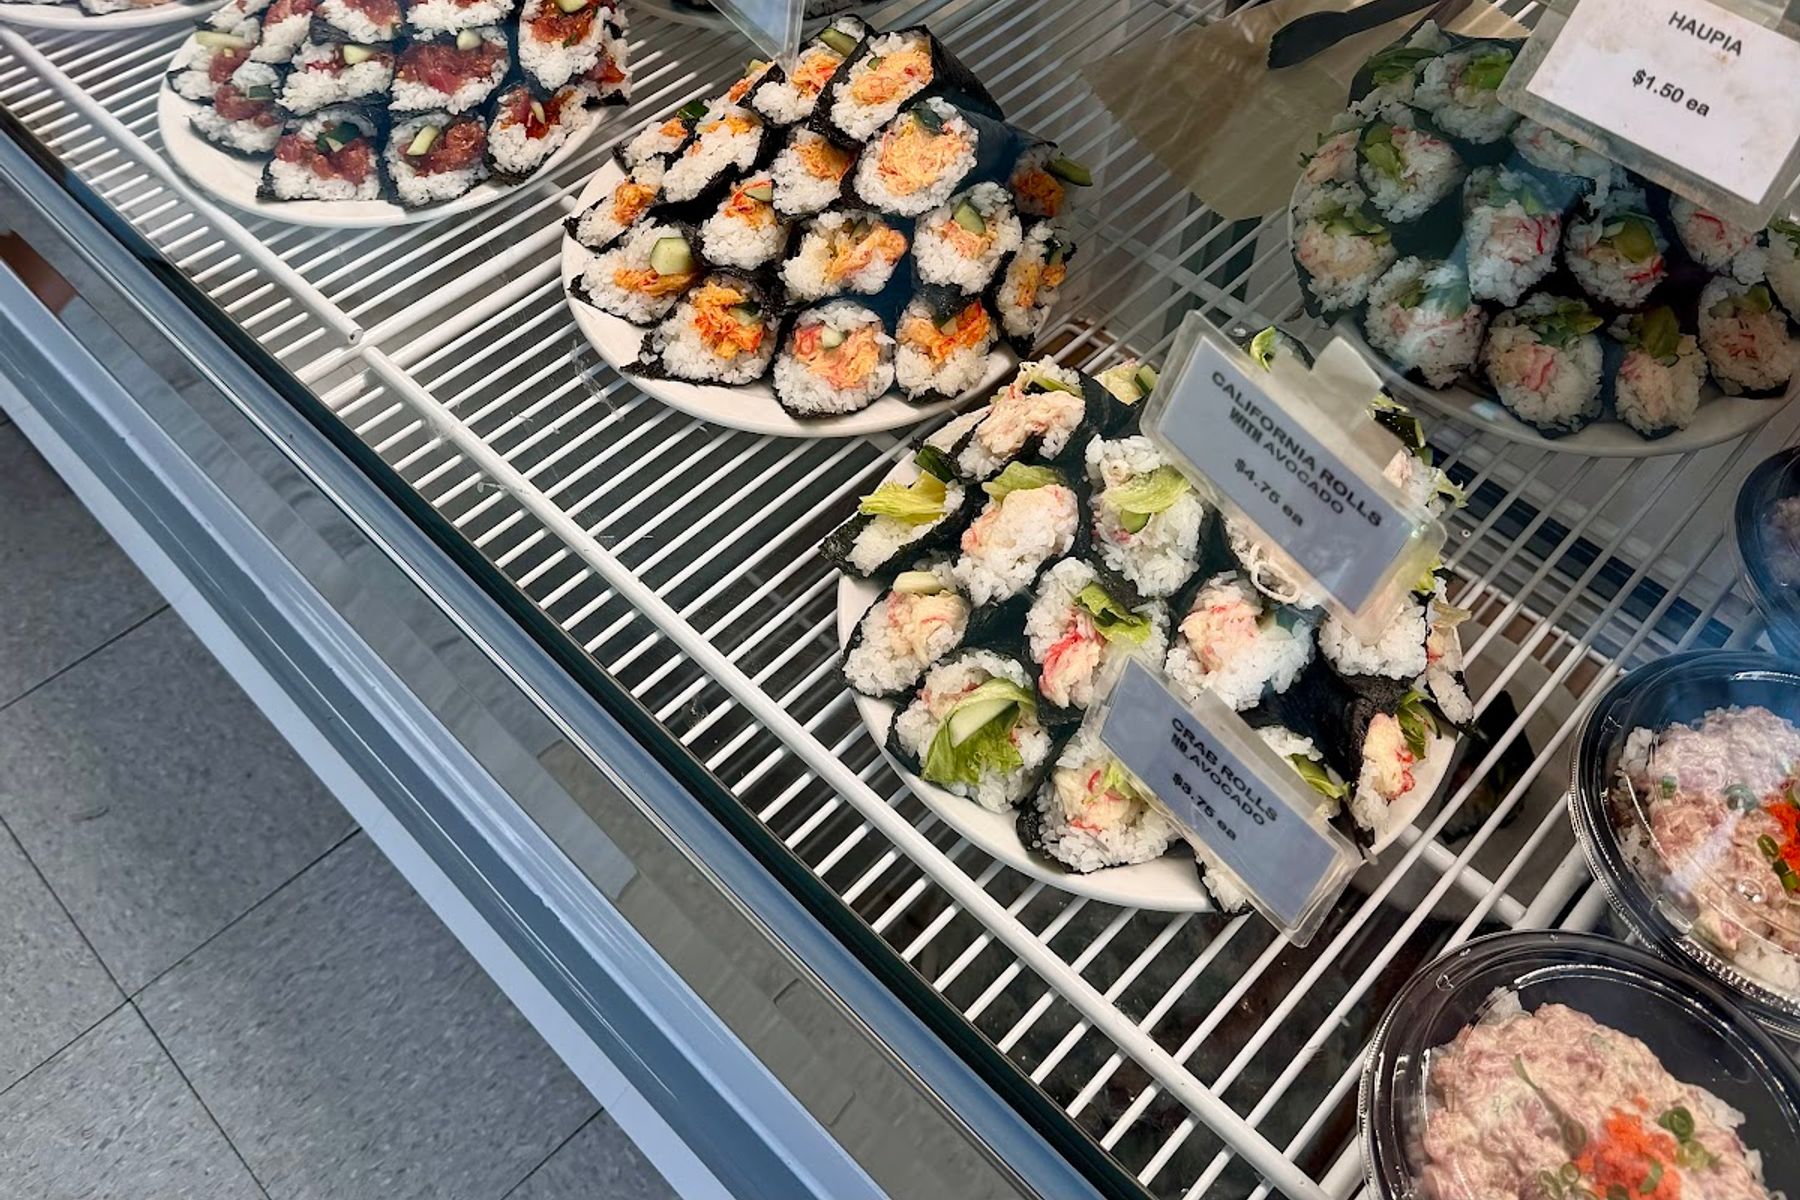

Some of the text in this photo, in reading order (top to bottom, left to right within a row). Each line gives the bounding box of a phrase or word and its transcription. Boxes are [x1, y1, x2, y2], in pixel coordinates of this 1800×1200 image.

[1668, 11, 1743, 56] HAUPIA
[1632, 69, 1710, 117] $1.50 ea
[1211, 371, 1383, 527] CALIFORNIA ROLLS
[1263, 440, 1345, 515] AVOCADO
[1234, 458, 1304, 527] $4.75 ea
[1171, 717, 1278, 822] CRAB ROLLS
[1189, 754, 1266, 826] AVOCADO
[1172, 772, 1237, 841] $3.75 ea
